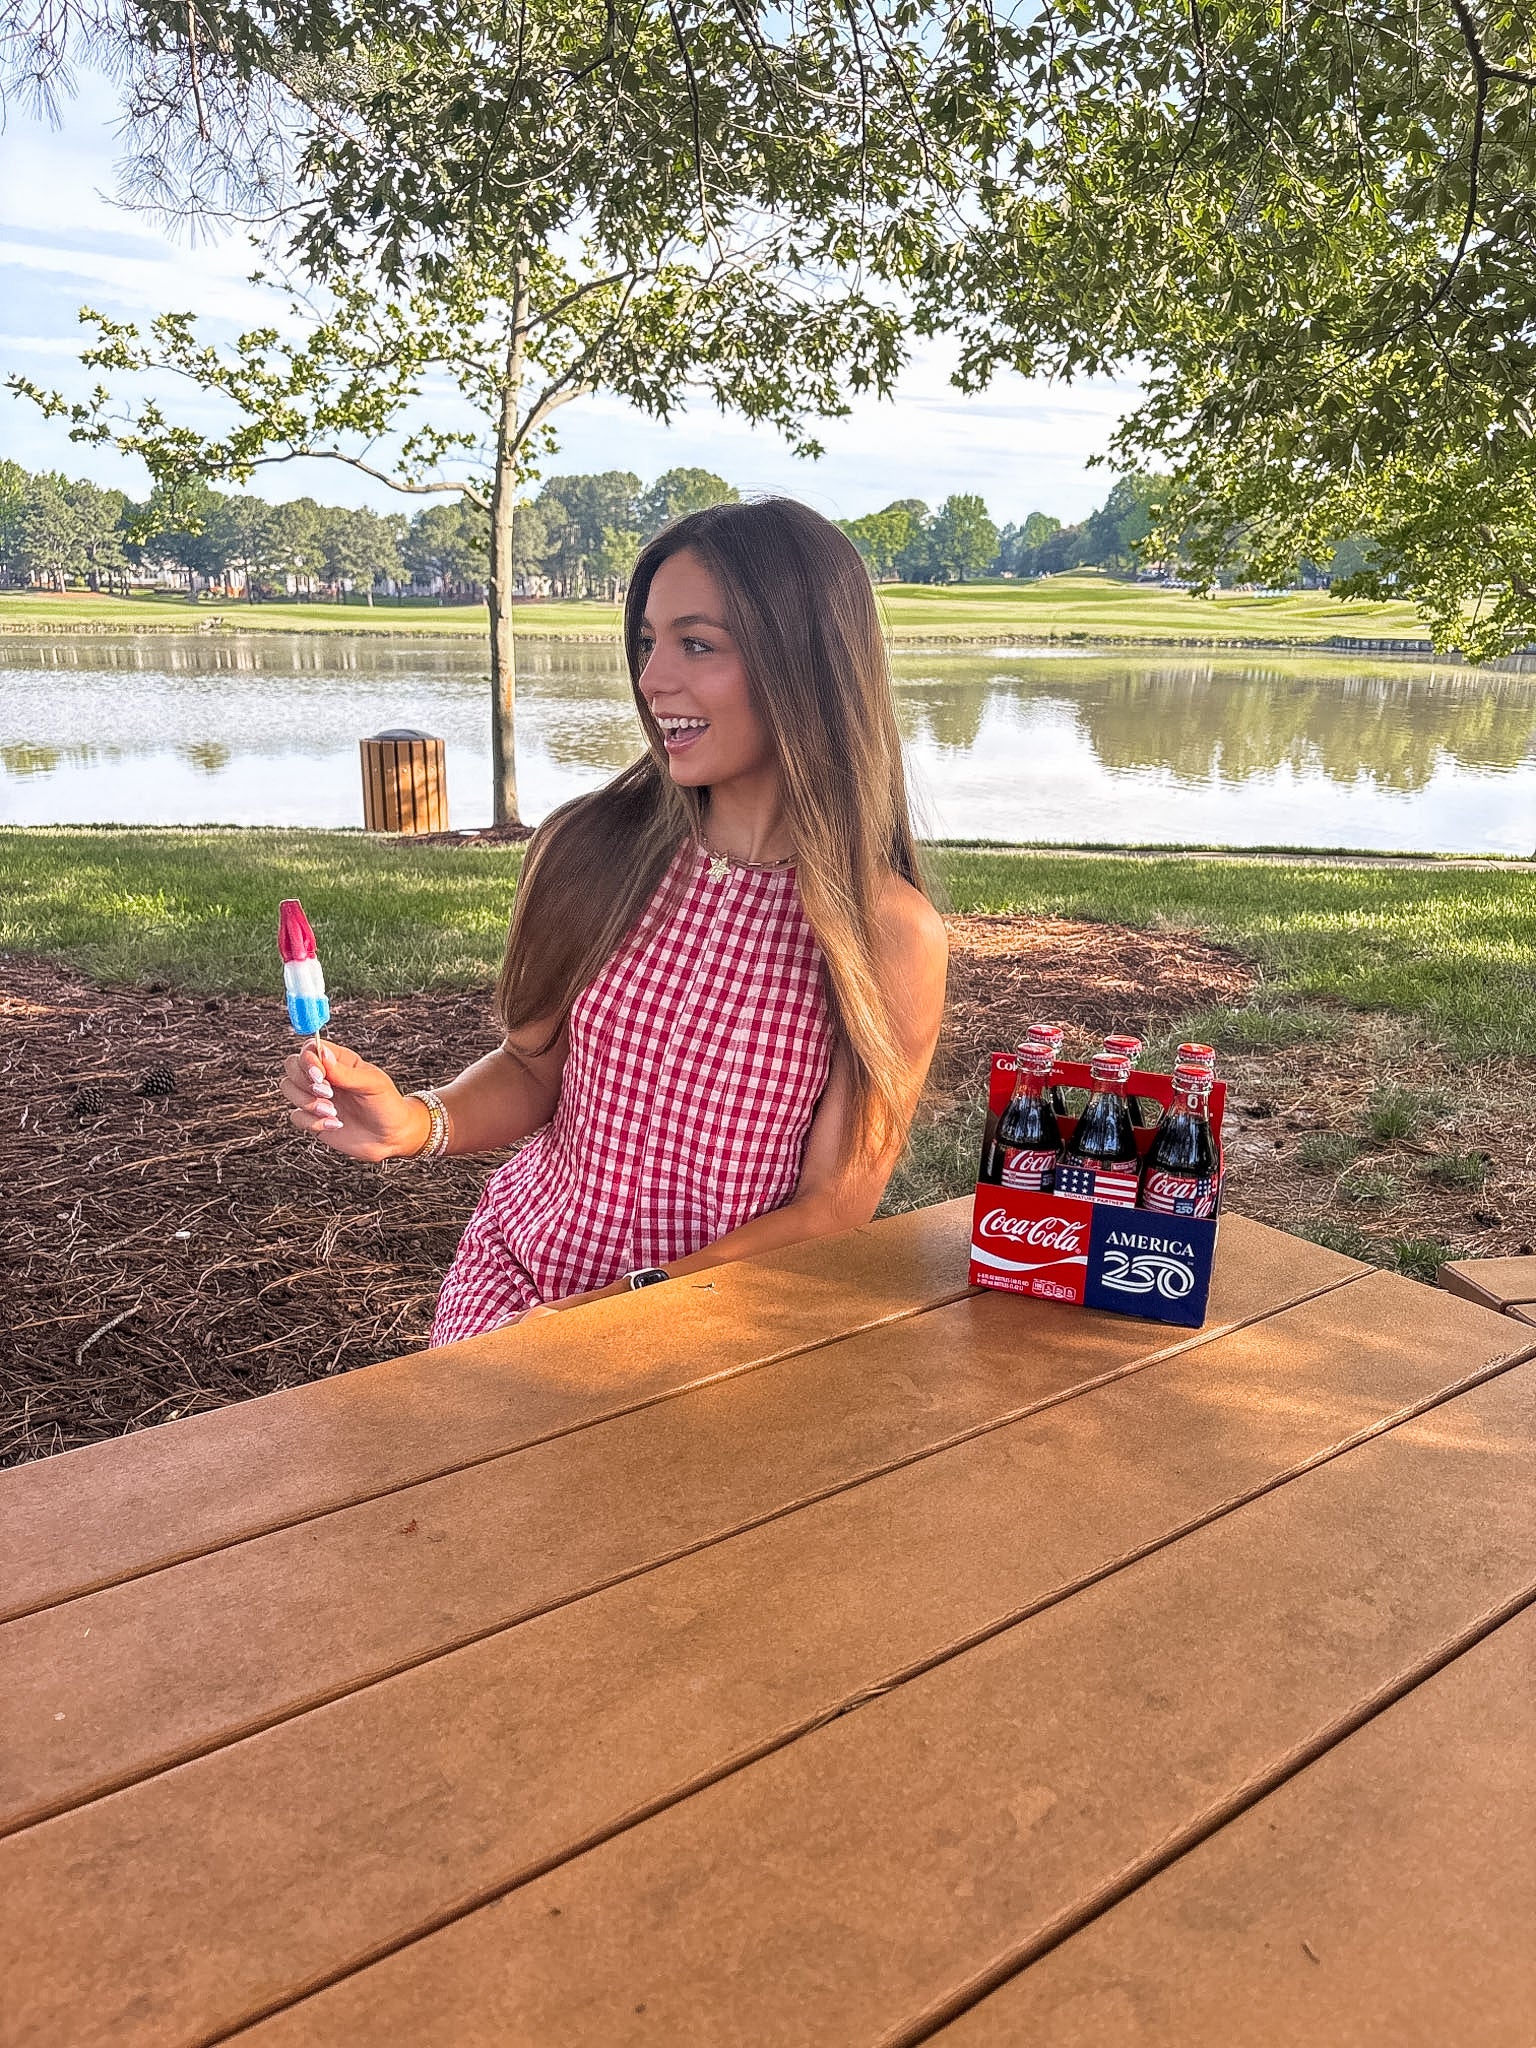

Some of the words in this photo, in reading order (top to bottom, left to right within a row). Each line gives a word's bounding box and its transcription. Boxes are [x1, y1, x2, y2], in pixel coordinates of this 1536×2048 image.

[979, 1208, 1088, 1252] Coca-Cola
[1105, 1230, 1195, 1257] AMERICA
[1101, 1250, 1195, 1300] 250
